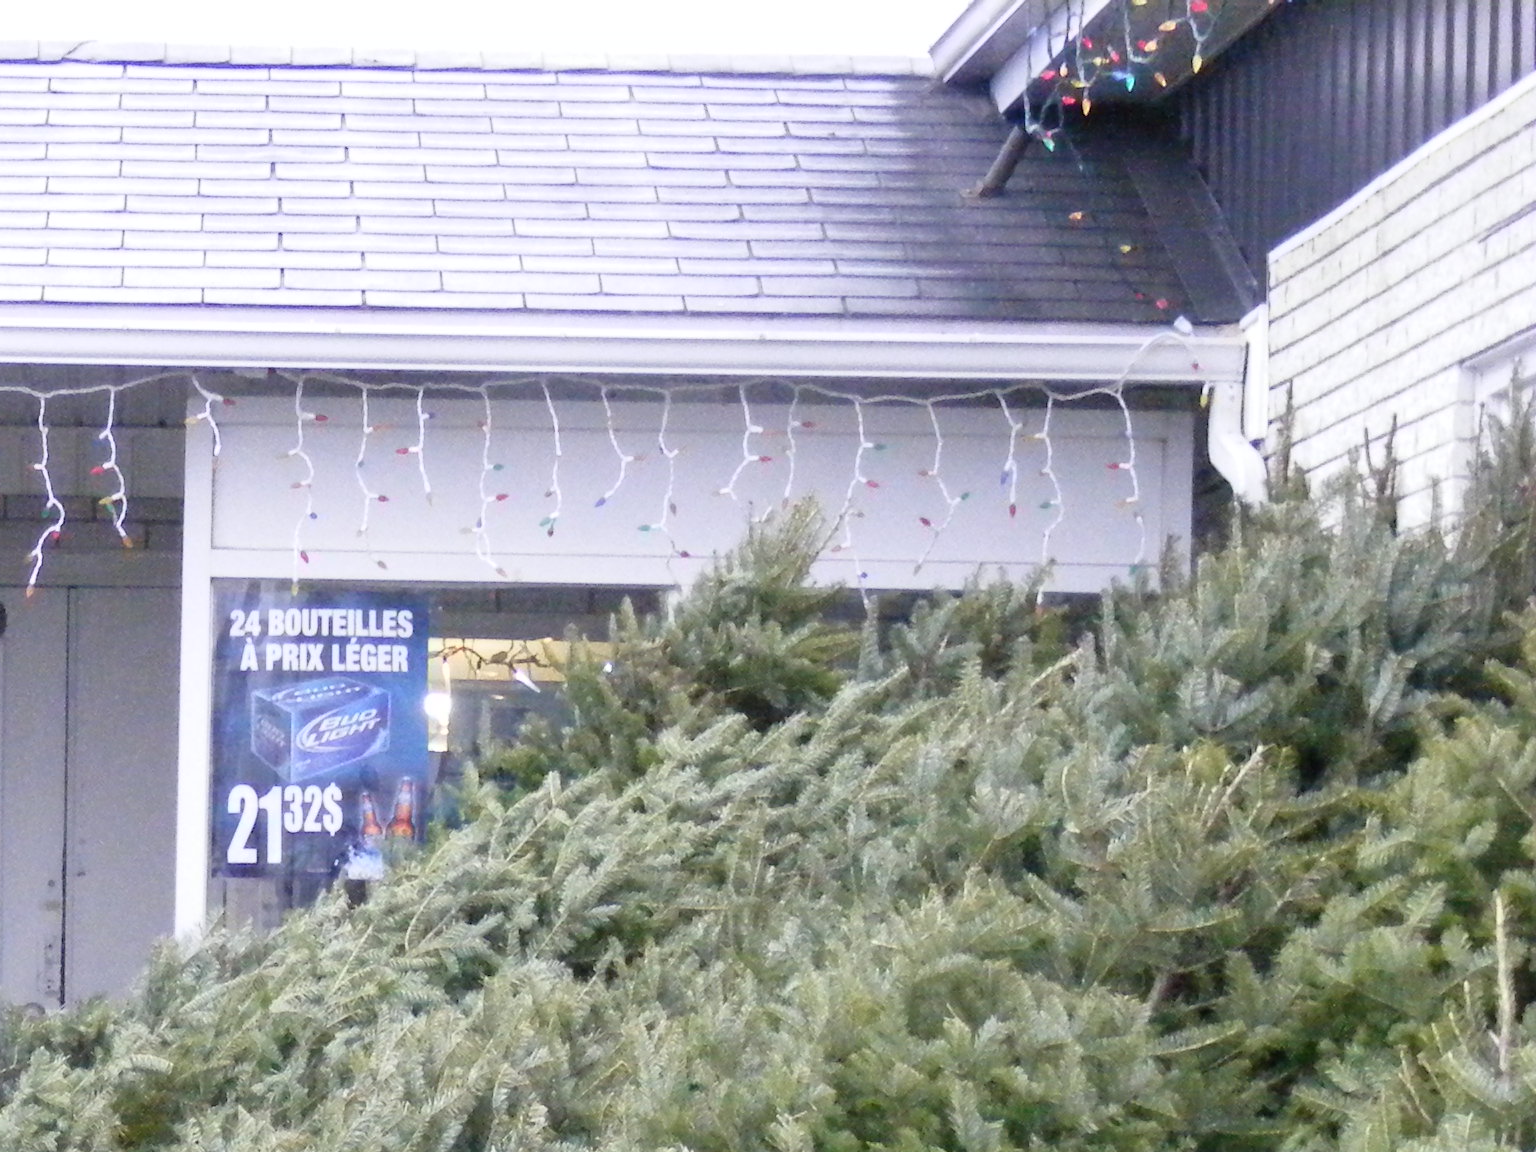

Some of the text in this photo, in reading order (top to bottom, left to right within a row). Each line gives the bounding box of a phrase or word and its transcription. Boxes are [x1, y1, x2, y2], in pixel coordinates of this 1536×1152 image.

[229, 608, 413, 638] 24 BOUTEILLES
[239, 637, 408, 672] À PRIX LÉGER
[305, 718, 381, 747] LIGHT
[318, 709, 377, 732] BUD
